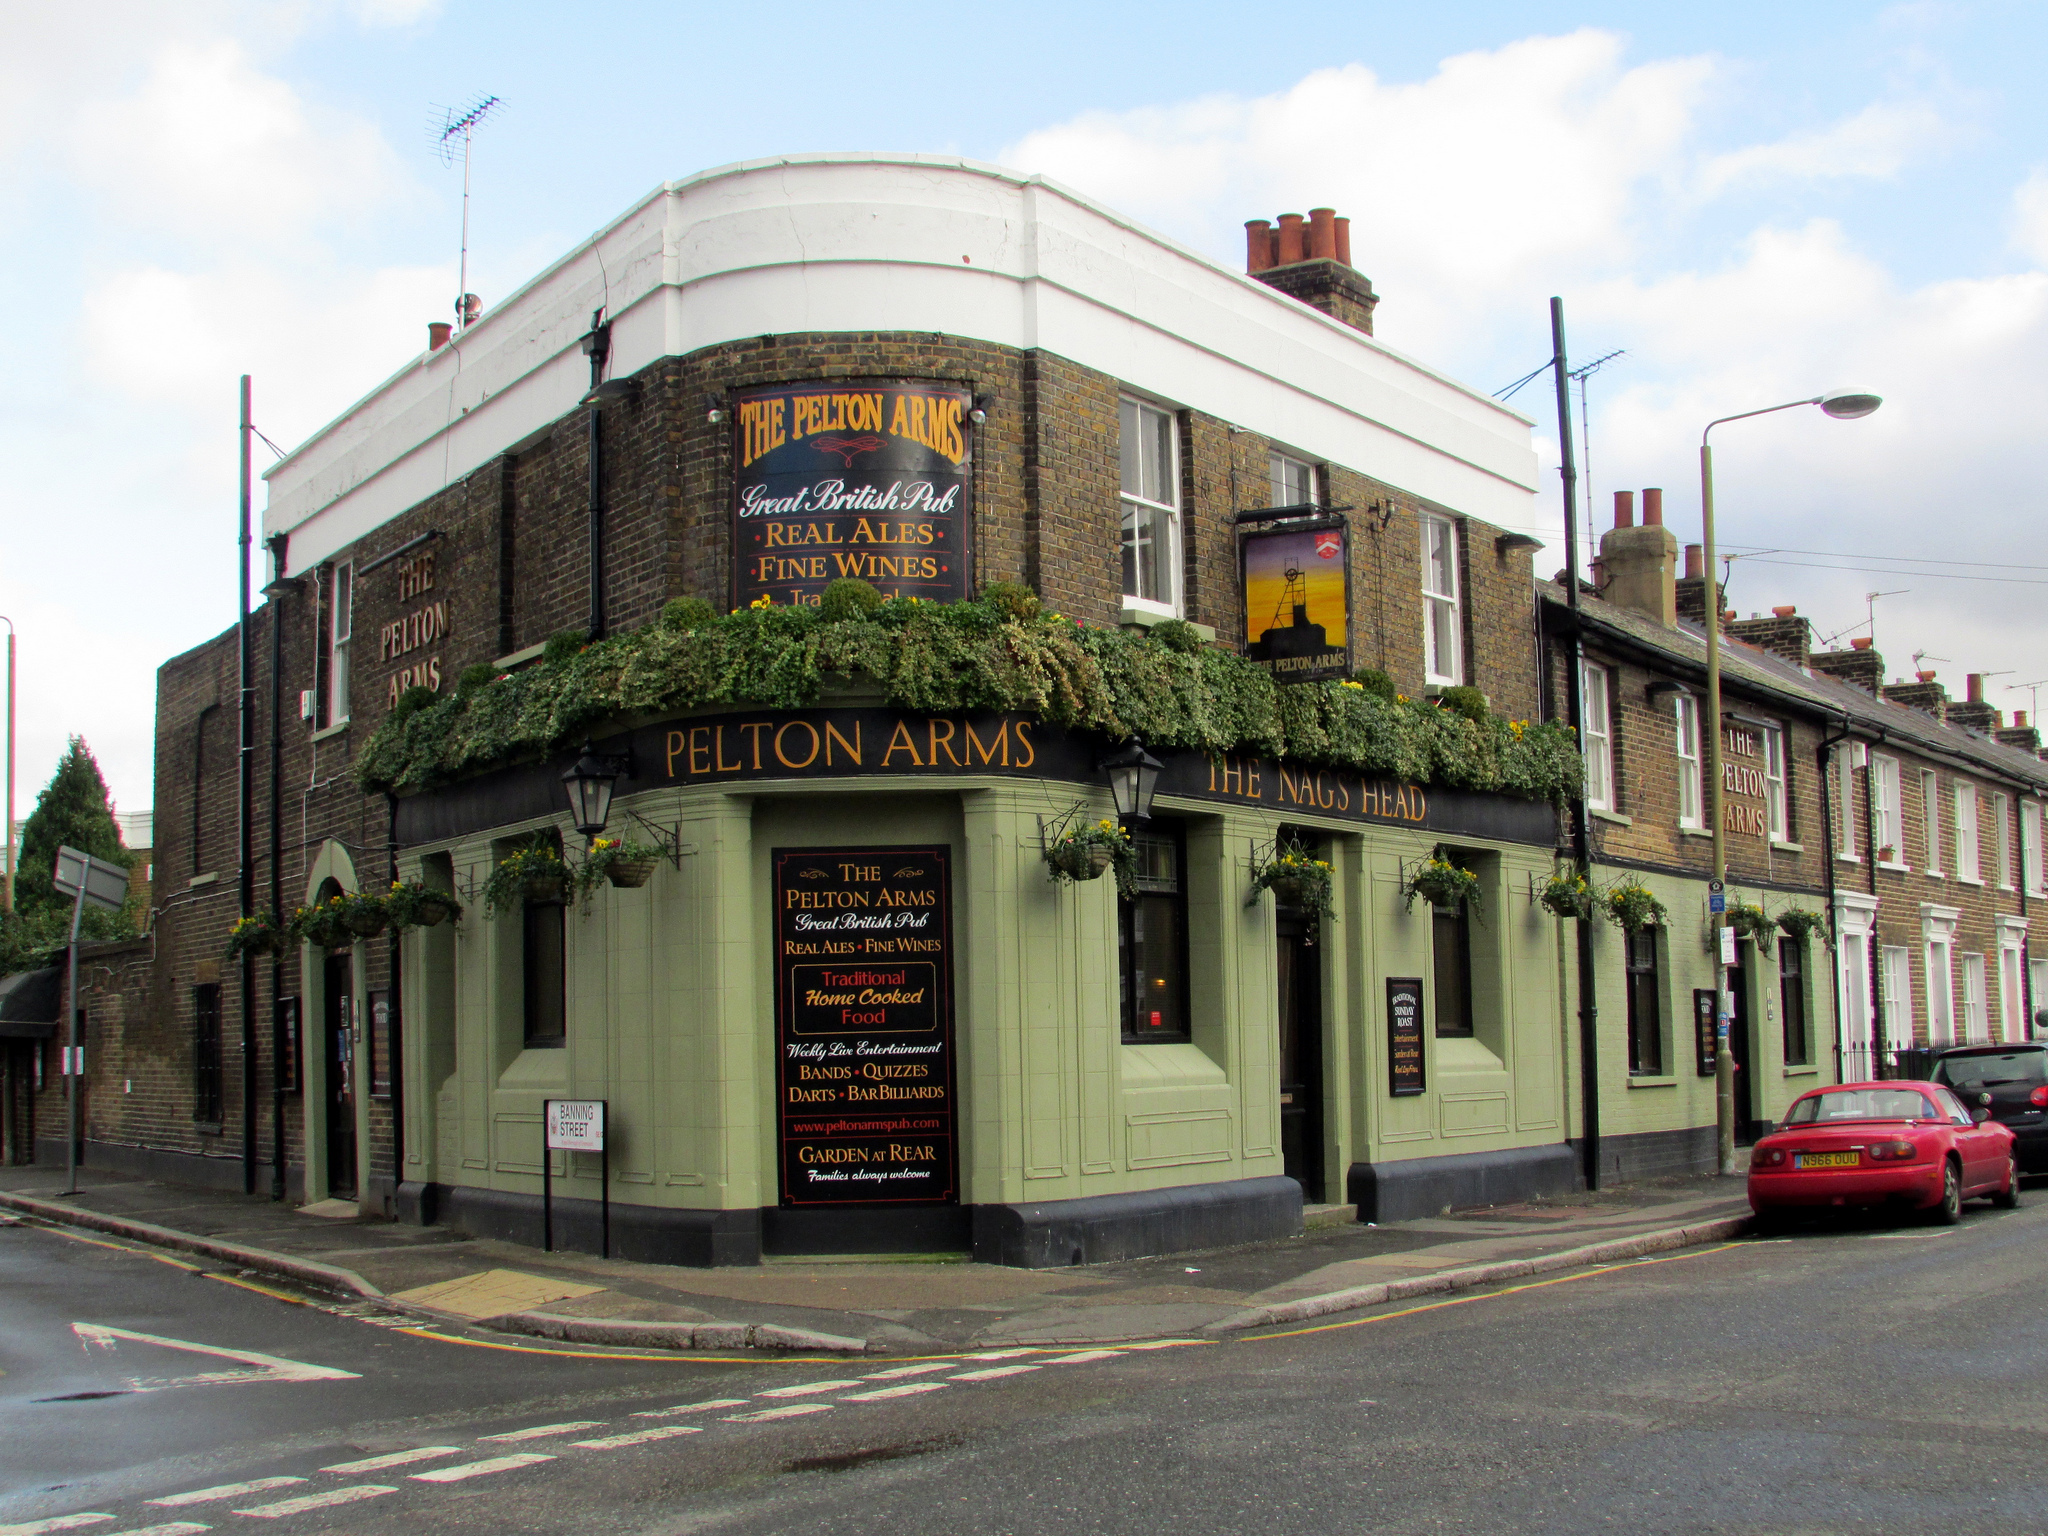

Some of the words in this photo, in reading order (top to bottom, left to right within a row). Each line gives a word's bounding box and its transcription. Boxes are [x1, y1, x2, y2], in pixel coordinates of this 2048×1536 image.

[740, 398, 786, 467] THE
[791, 394, 884, 440] PELTON
[889, 395, 964, 466] ARMS
[739, 484, 809, 517] Great
[805, 479, 902, 512] British
[900, 481, 960, 513] Pub
[764, 522, 844, 547] REAL
[849, 518, 934, 545] ALES
[399, 552, 435, 602] THE
[758, 556, 826, 582] FINE
[832, 552, 938, 579] WINES
[381, 599, 449, 662] PELTON
[1276, 655, 1312, 673] PELTON
[1315, 652, 1345, 668] ARMS
[388, 656, 440, 710] ARMS
[666, 720, 862, 778] PELTON
[881, 718, 1035, 768] ARMS
[1728, 728, 1753, 757] THE
[1203, 751, 1261, 798] THE
[1278, 764, 1349, 811] NAGS
[1361, 778, 1426, 822] HEAD
[1726, 804, 1764, 837] ARMS
[838, 864, 881, 881] THE
[786, 889, 869, 909] PELTON
[875, 888, 936, 907] ARMS
[795, 913, 839, 931] Great
[839, 912, 892, 930] British
[894, 911, 930, 928] Pub
[785, 940, 820, 955] REAL
[822, 940, 855, 954] ALES
[865, 938, 895, 953] FINE
[896, 937, 941, 952] WINES
[822, 970, 905, 986] Traditional
[806, 989, 855, 1006] Home
[859, 988, 924, 1005] Cooked
[842, 1009, 886, 1024] Food
[1394, 1006, 1414, 1016] SUNDAY
[787, 1043, 827, 1061] Weekly
[828, 1042, 853, 1056] Live
[856, 1041, 943, 1056] Entertainment
[800, 1065, 851, 1080] BANDS
[863, 1063, 928, 1080] QUIZZES
[789, 1087, 836, 1102] DARTS
[848, 1085, 878, 1101] BAR
[879, 1084, 944, 1100] BILLIARDS
[560, 1105, 593, 1120] BANNING
[560, 1122, 588, 1137] STREET
[794, 1118, 939, 1135] www.peltonarmspub.com
[799, 1146, 869, 1164] GARDEN
[872, 1151, 886, 1162] AT
[890, 1144, 937, 1162] REAR
[1802, 1154, 1831, 1166] N966
[808, 1169, 849, 1182] Families
[852, 1168, 888, 1183] always
[890, 1168, 930, 1180] welcome
